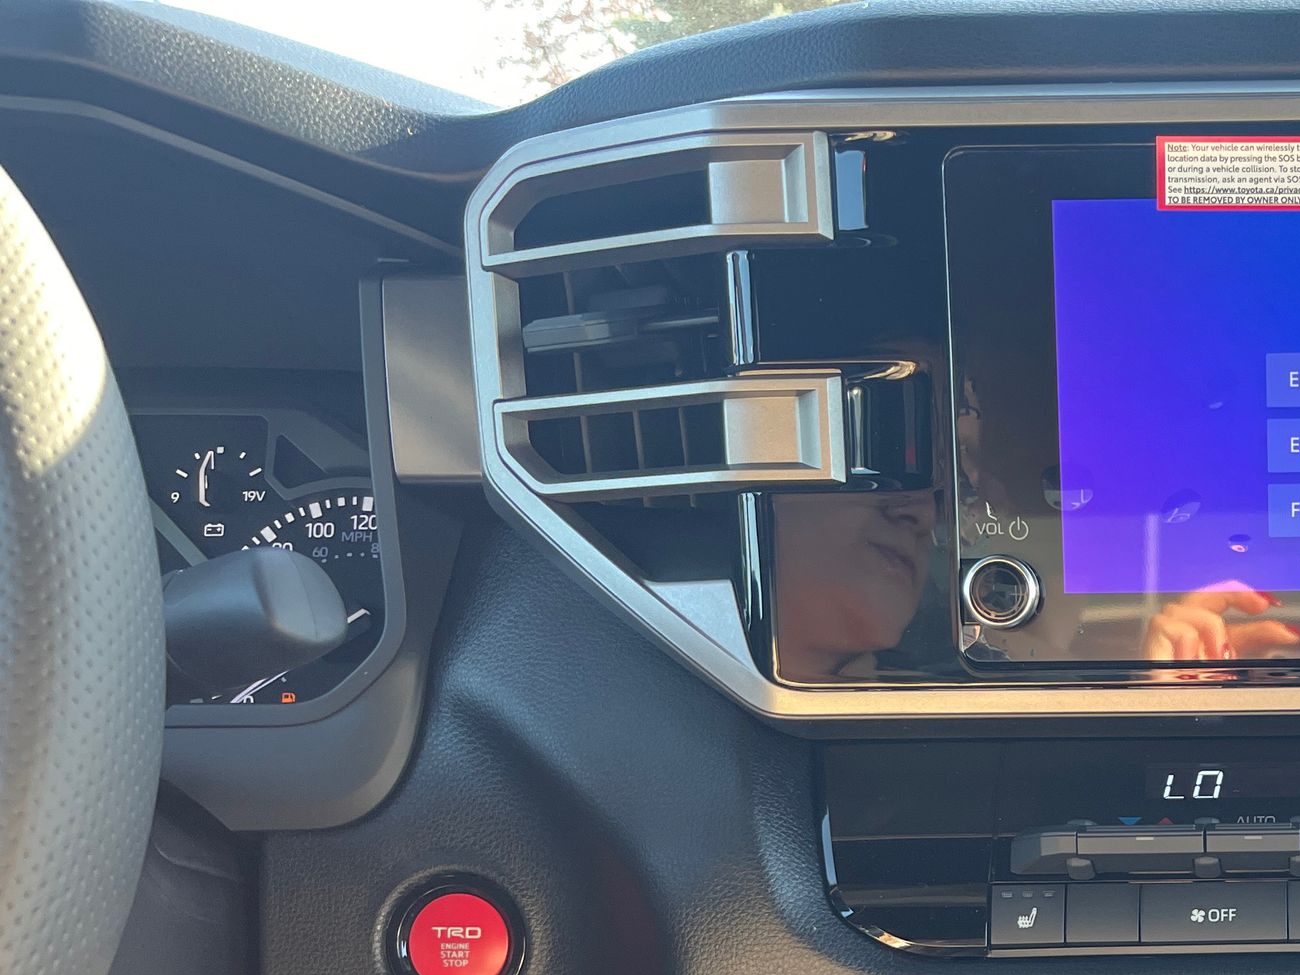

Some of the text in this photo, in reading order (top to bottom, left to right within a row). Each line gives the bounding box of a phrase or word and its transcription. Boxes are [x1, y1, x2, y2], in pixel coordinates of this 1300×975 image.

[1167, 143, 1189, 152] Note:
[1210, 142, 1239, 151] vehicle
[1239, 142, 1254, 151] can
[1255, 142, 1295, 153] wirelessly
[1167, 154, 1199, 162] location
[1199, 154, 1217, 162] data
[1218, 154, 1229, 164] by
[1229, 155, 1263, 164] pressing
[1264, 154, 1277, 162] the
[1278, 154, 1295, 162] SOS
[1177, 164, 1204, 174] during
[1211, 164, 1240, 173] vehicle
[1241, 164, 1276, 173] collision.
[1278, 164, 1288, 173] To
[1167, 175, 1220, 184] transmission,
[1221, 175, 1235, 183] ask
[1248, 176, 1272, 185] agent
[1167, 185, 1182, 193] See
[1168, 196, 1180, 205] TO
[1181, 196, 1191, 205] BE
[1193, 196, 1234, 205] REMOVED
[1235, 196, 1246, 205] BY
[1248, 196, 1280, 205] OWNER
[171, 492, 180, 504] 9
[242, 491, 266, 503] 19V
[305, 523, 335, 539] 100
[976, 523, 1005, 535] VOL
[341, 531, 374, 543] MPH
[312, 547, 329, 559] 60
[1163, 770, 1224, 800] LO
[1237, 815, 1276, 824] AUTO
[1208, 908, 1237, 923] OFF
[432, 926, 482, 940] TRD
[441, 943, 470, 951] ENGINE
[440, 950, 470, 959] START
[443, 959, 470, 968] STOP
